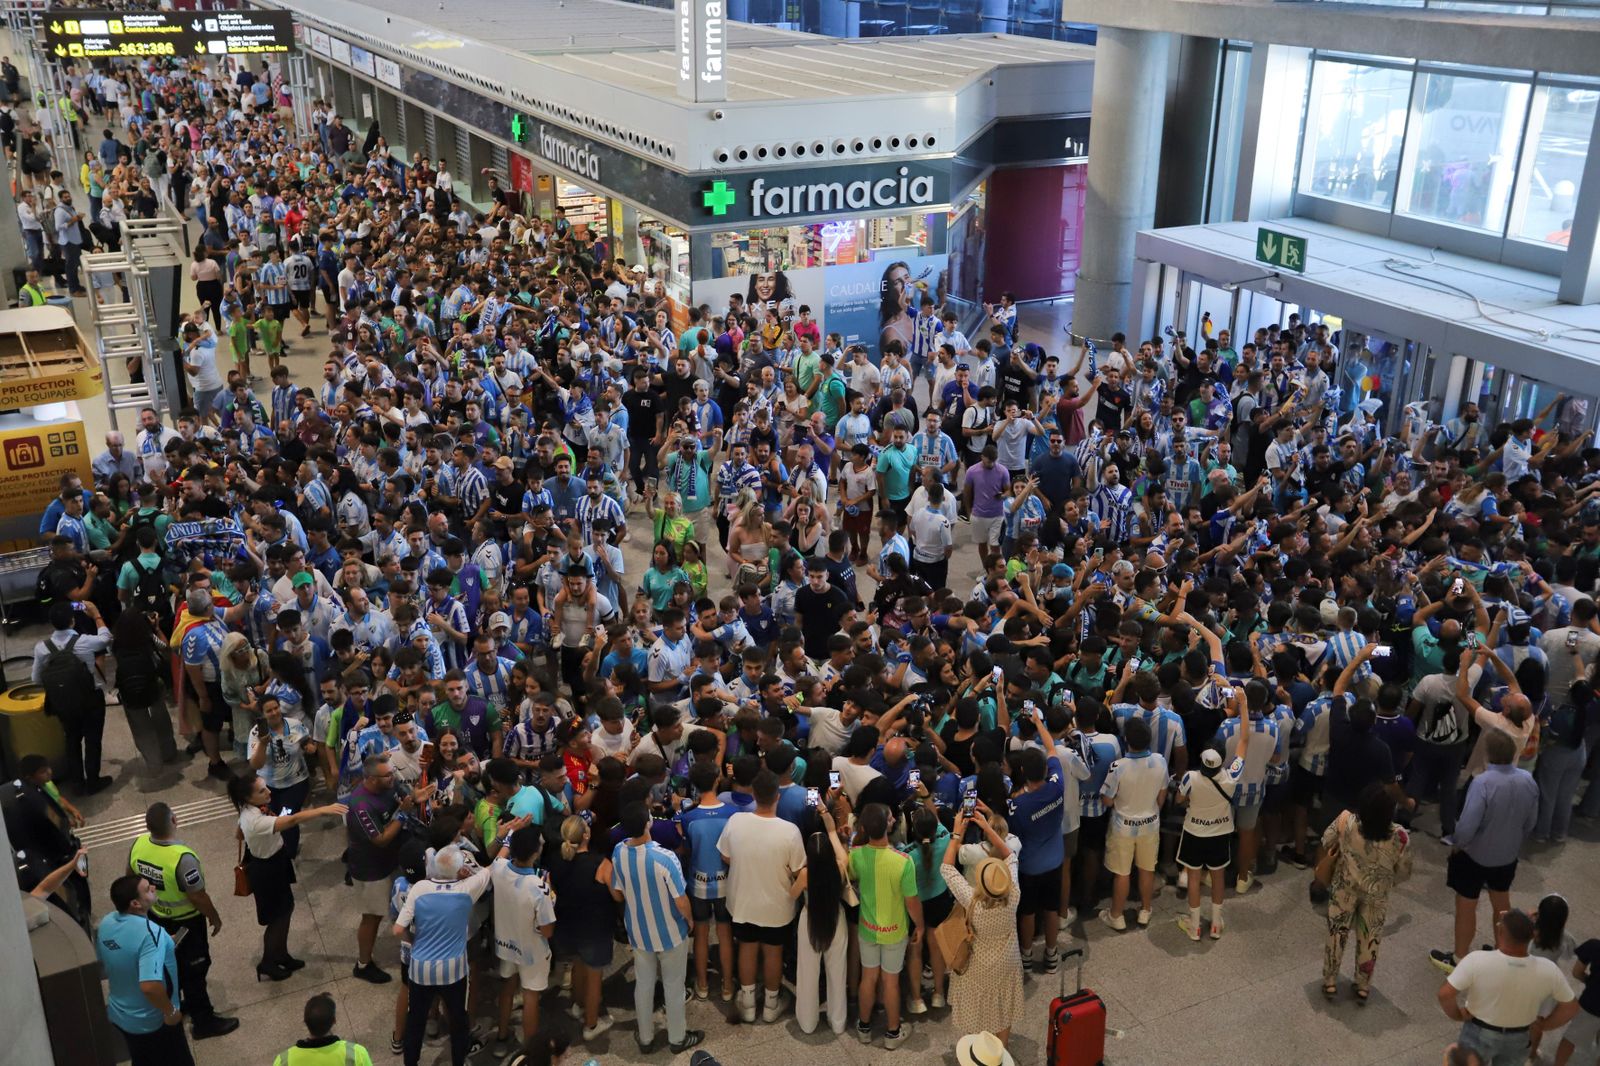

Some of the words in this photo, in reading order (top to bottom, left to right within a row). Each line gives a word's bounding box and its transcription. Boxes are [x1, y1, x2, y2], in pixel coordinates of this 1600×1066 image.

[680, 0, 690, 80] farma
[702, 1, 722, 82] farma
[119, 43, 144, 55] 363
[149, 42, 174, 55] 386
[540, 124, 600, 180] farmacia
[751, 166, 934, 216] farmacia
[294, 264, 307, 279] 20
[830, 280, 888, 297] CAUDALIE
[2, 378, 75, 395] PROTECTION
[24, 387, 77, 402] EQUIPAJES
[22, 467, 76, 480] PROTECTION
[1169, 480, 1189, 488] Tivoli
[137, 863, 163, 879] Trablisa
